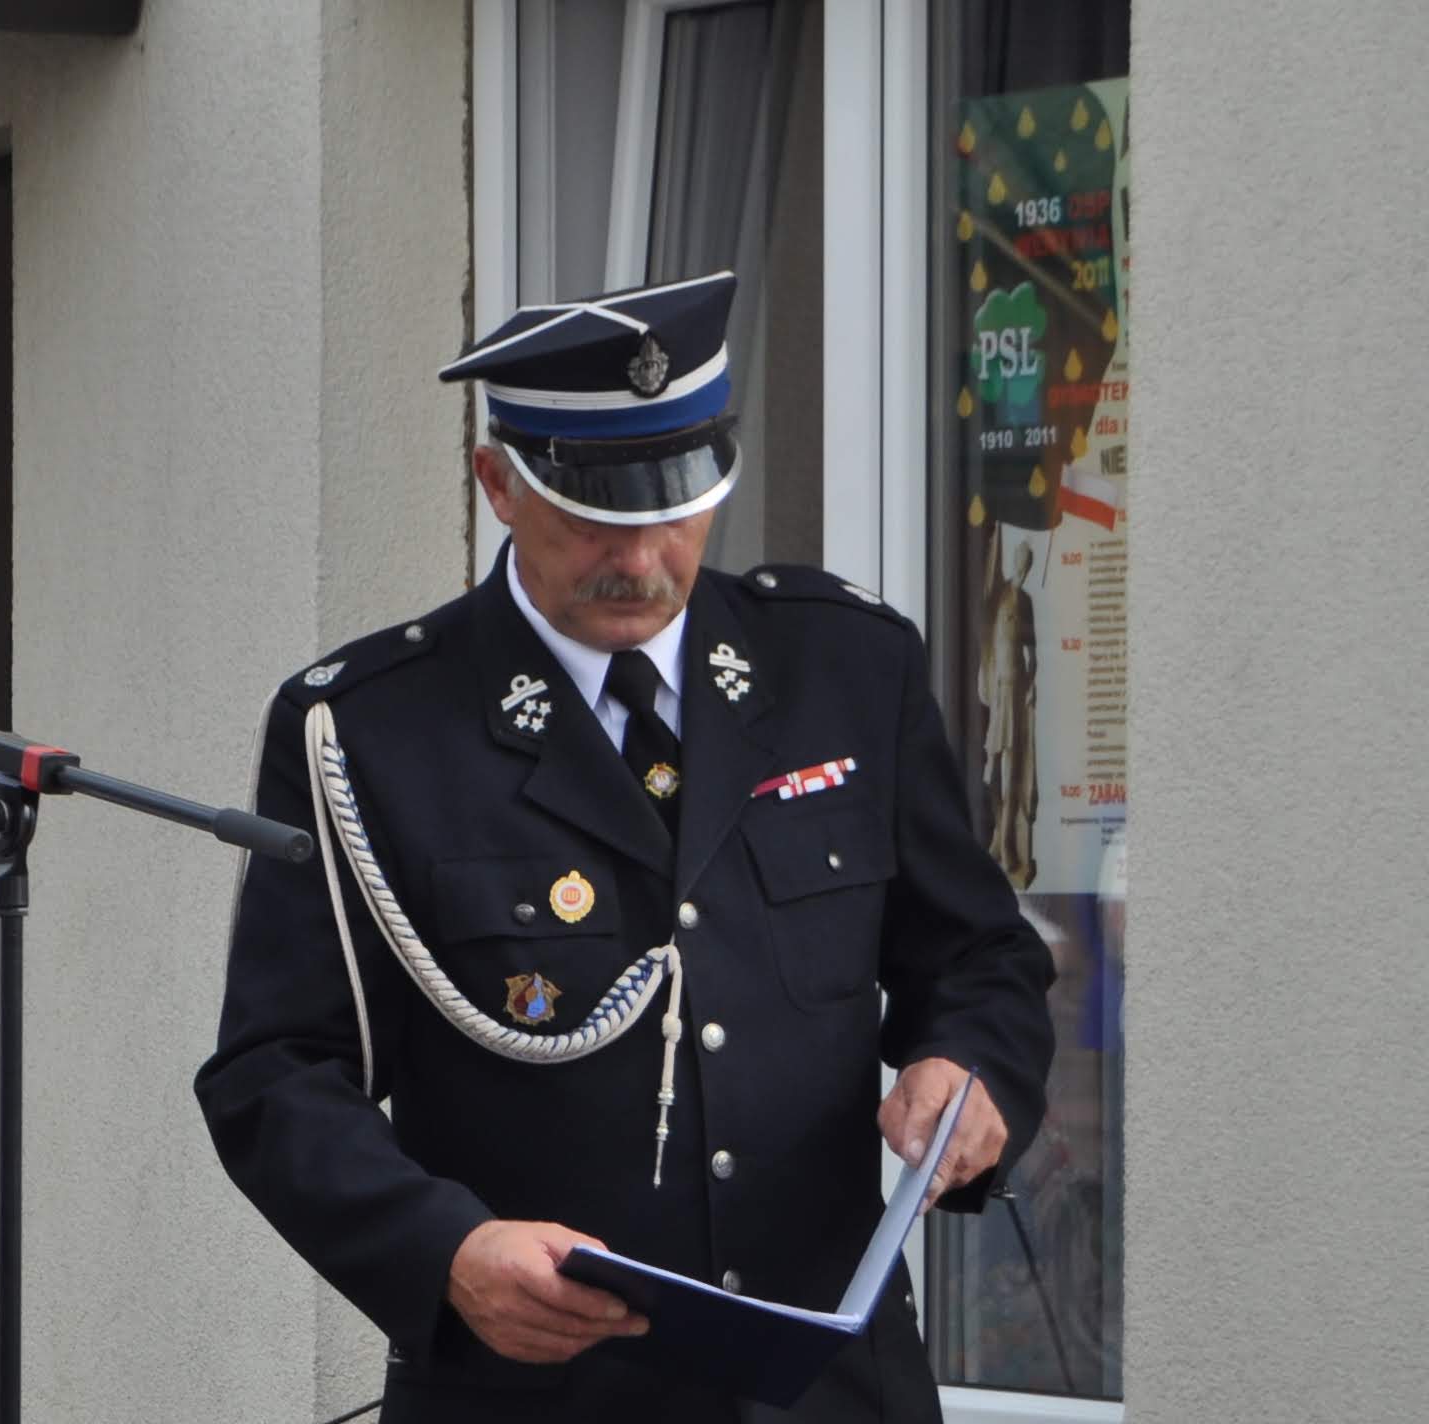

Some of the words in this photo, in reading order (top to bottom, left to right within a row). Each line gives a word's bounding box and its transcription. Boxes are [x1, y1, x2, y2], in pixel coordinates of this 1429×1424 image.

[1014, 195, 1061, 228] 1936
[1070, 256, 1110, 291] 2011
[977, 325, 1038, 380] PSL
[979, 428, 1013, 450] 1910
[1024, 424, 1058, 448] 2011
